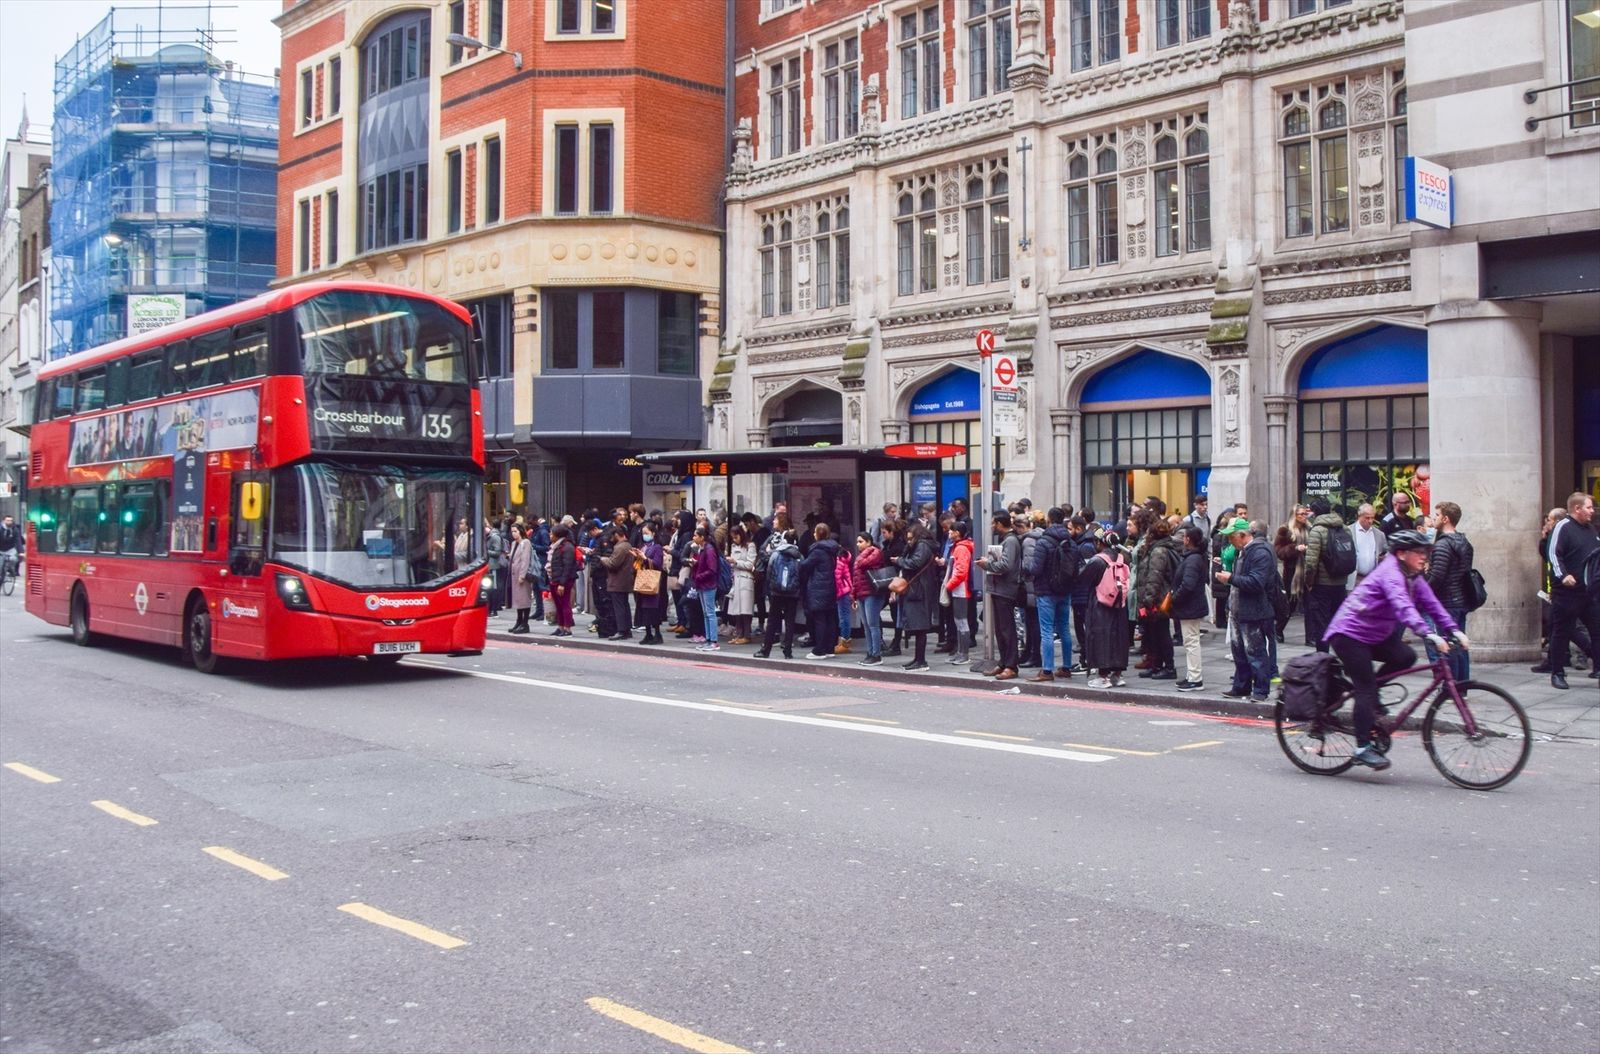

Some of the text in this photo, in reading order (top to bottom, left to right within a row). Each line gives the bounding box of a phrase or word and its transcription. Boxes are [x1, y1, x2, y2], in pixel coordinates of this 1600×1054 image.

[1418, 170, 1447, 191] TESCO
[1418, 193, 1447, 212] express
[166, 309, 180, 317] LTD
[980, 333, 992, 351] K
[314, 407, 452, 439] Crossharbour 135
[350, 425, 370, 433] ASDA
[785, 426, 799, 436] 164
[647, 473, 681, 484] CORAL
[1306, 472, 1339, 480] Partnering
[379, 596, 430, 608] Stagecoach
[229, 602, 259, 618] Stagecoach
[379, 642, 416, 653] BU16 UXH
